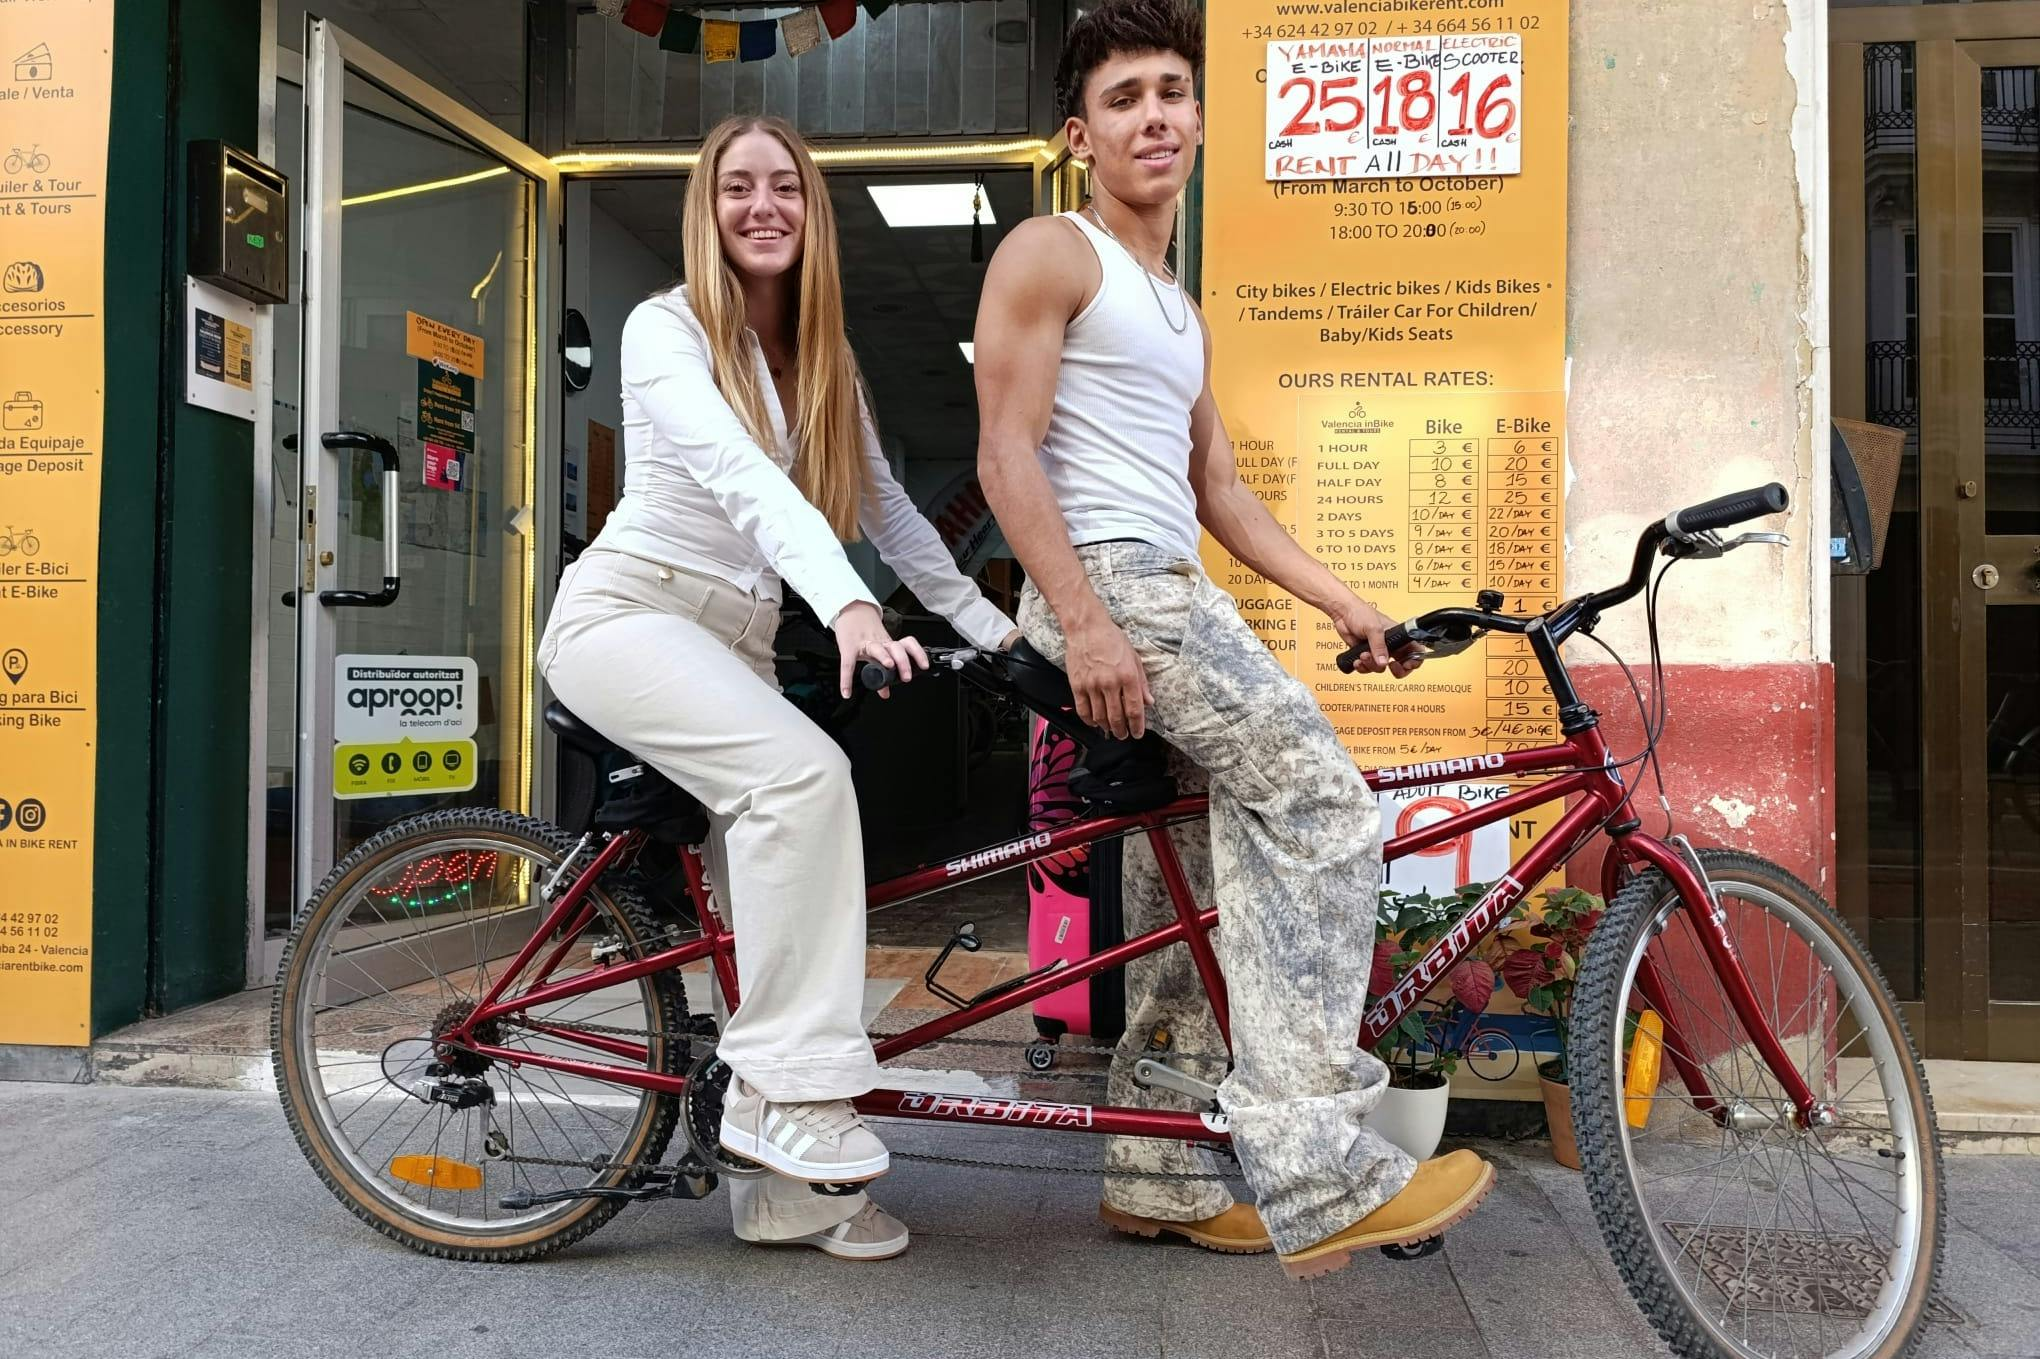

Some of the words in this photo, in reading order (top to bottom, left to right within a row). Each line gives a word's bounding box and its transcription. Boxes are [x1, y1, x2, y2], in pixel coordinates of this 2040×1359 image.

[1276, 0, 1504, 15] www.valenciabikerent.com
[1242, 26, 1272, 39] +34
[1277, 24, 1307, 38] 624
[1310, 23, 1332, 36] 42
[1334, 22, 1354, 36] 97
[1358, 21, 1378, 35] 02
[1413, 20, 1433, 33] 34
[1437, 19, 1467, 32] 664
[1472, 18, 1491, 31] 56
[1496, 17, 1514, 30] 11
[1520, 16, 1540, 29] 02
[1372, 38, 1438, 54] NORMAL
[1442, 36, 1517, 49] ELECTRIC
[1279, 43, 1365, 61] YAMAHA
[32, 86, 75, 99] Venta
[1278, 77, 1365, 137] 25
[1373, 70, 1436, 135] 18
[1448, 72, 1516, 139] 16
[1268, 139, 1293, 149] CASH
[1372, 138, 1397, 146] CASH
[1441, 138, 1467, 147] CASH
[1275, 155, 1357, 177] RENT
[48, 179, 82, 192] Tour
[1273, 179, 1327, 199] (From
[1332, 177, 1390, 195] March
[1396, 178, 1414, 192] to
[1419, 176, 1504, 193] October)
[30, 202, 72, 215] Tours
[1334, 203, 1367, 217] 9:30
[1371, 202, 1393, 216] TO
[1330, 225, 1372, 240] 18:00
[1375, 224, 1398, 239] TO
[1236, 283, 1268, 301] City
[1272, 283, 1316, 297] bikes
[1331, 281, 1393, 297] Electric
[1396, 281, 1440, 295] bikes
[1456, 279, 1492, 294] Kids
[1496, 279, 1540, 294] Bikes
[0, 298, 66, 312] cesorios
[1249, 306, 1323, 321] Tandems
[1337, 304, 1390, 319] Tráiler
[1394, 304, 1422, 318] Car
[1427, 303, 1453, 317] For
[1458, 301, 1537, 317] Children/
[1320, 327, 1404, 345] Baby/Kids
[1408, 326, 1453, 341] Seats
[1278, 373, 1334, 388] OURS
[1340, 371, 1418, 387] RENTAL
[1424, 371, 1494, 386] RATES:
[1321, 420, 1362, 428] Valencia
[1426, 419, 1463, 435] Bike
[1496, 417, 1551, 434] E-Bike
[20, 436, 85, 451] Equipaje
[1240, 440, 1274, 451] HOUR
[1317, 445, 1323, 453] 1
[1328, 444, 1368, 452] HOUR
[1433, 441, 1447, 454] 3
[1514, 440, 1525, 454] 6
[27, 459, 84, 474] Deposit
[1236, 457, 1258, 468] ULL
[1261, 457, 1284, 467] DAY
[1317, 462, 1349, 470] FULL
[1353, 461, 1380, 470] DAY
[1432, 457, 1452, 471] 10
[1505, 457, 1528, 471] 20
[1317, 479, 1351, 487] HALF
[1355, 479, 1382, 487] DAY
[1434, 474, 1446, 488] 8
[1506, 473, 1527, 486] 15
[1317, 496, 1332, 504] 24
[1336, 496, 1383, 504] HOURS
[1429, 491, 1451, 504] 12
[1504, 491, 1528, 505] 25
[1317, 513, 1324, 521] 2
[1328, 512, 1362, 521] DAYS
[1327, 529, 1344, 537] TO
[1360, 529, 1394, 537] DAYS
[1316, 545, 1324, 553] 6
[1326, 545, 1343, 553] TO
[1347, 545, 1361, 553] 10
[1364, 544, 1396, 553] DAYS
[26, 562, 69, 575] E-Bici
[1331, 562, 1347, 571] TO
[1351, 562, 1363, 571] 15
[1366, 562, 1397, 571] DAYS
[1228, 575, 1241, 585] 20
[1350, 581, 1360, 589] TO
[1368, 580, 1399, 589] MONTH
[11, 585, 58, 598] E-Bike
[1236, 598, 1292, 610] UGGAGE
[1514, 598, 1527, 613] 1
[1316, 641, 1345, 650] PHONE
[352, 669, 411, 679] Distribuïdor
[413, 670, 460, 680] autoritzat
[1503, 660, 1529, 675] 20
[1315, 683, 1361, 692] CHILDREN'S
[1363, 684, 1425, 693] TRAILER/CARRO
[1427, 684, 1472, 694] REMOLQUE
[1504, 678, 1529, 695] 10
[12, 693, 46, 706] para
[50, 690, 78, 704] Bici
[347, 684, 463, 717] aproop!
[1320, 704, 1391, 713] COOTER/PATINETE
[1393, 704, 1409, 713] FOR
[1417, 705, 1445, 713] HOURS
[1504, 701, 1529, 716] 15
[29, 713, 61, 727] Bike
[410, 719, 442, 727] telecom
[1357, 727, 1391, 735] DEPOSIT
[1393, 727, 1408, 736] PER
[1409, 728, 1440, 736] PERSON
[1442, 728, 1466, 736] FROM
[1353, 746, 1371, 754] BIKE
[1373, 746, 1395, 754] FROM
[1377, 753, 1505, 784] SHIMANO
[6, 839, 17, 848] IN
[20, 839, 46, 849] BIKE
[48, 840, 78, 850] RENT
[945, 831, 1052, 877] SHIMANO
[10, 913, 24, 923] 42
[27, 913, 42, 924] 97
[44, 914, 59, 924] 02
[10, 926, 24, 937] 56
[28, 927, 40, 937] 11
[44, 927, 59, 938] 02
[18, 944, 31, 954] 24
[41, 944, 89, 955] Valencia
[1364, 874, 1524, 1038] ORBITA
[898, 1091, 1093, 1128] ORBITA
